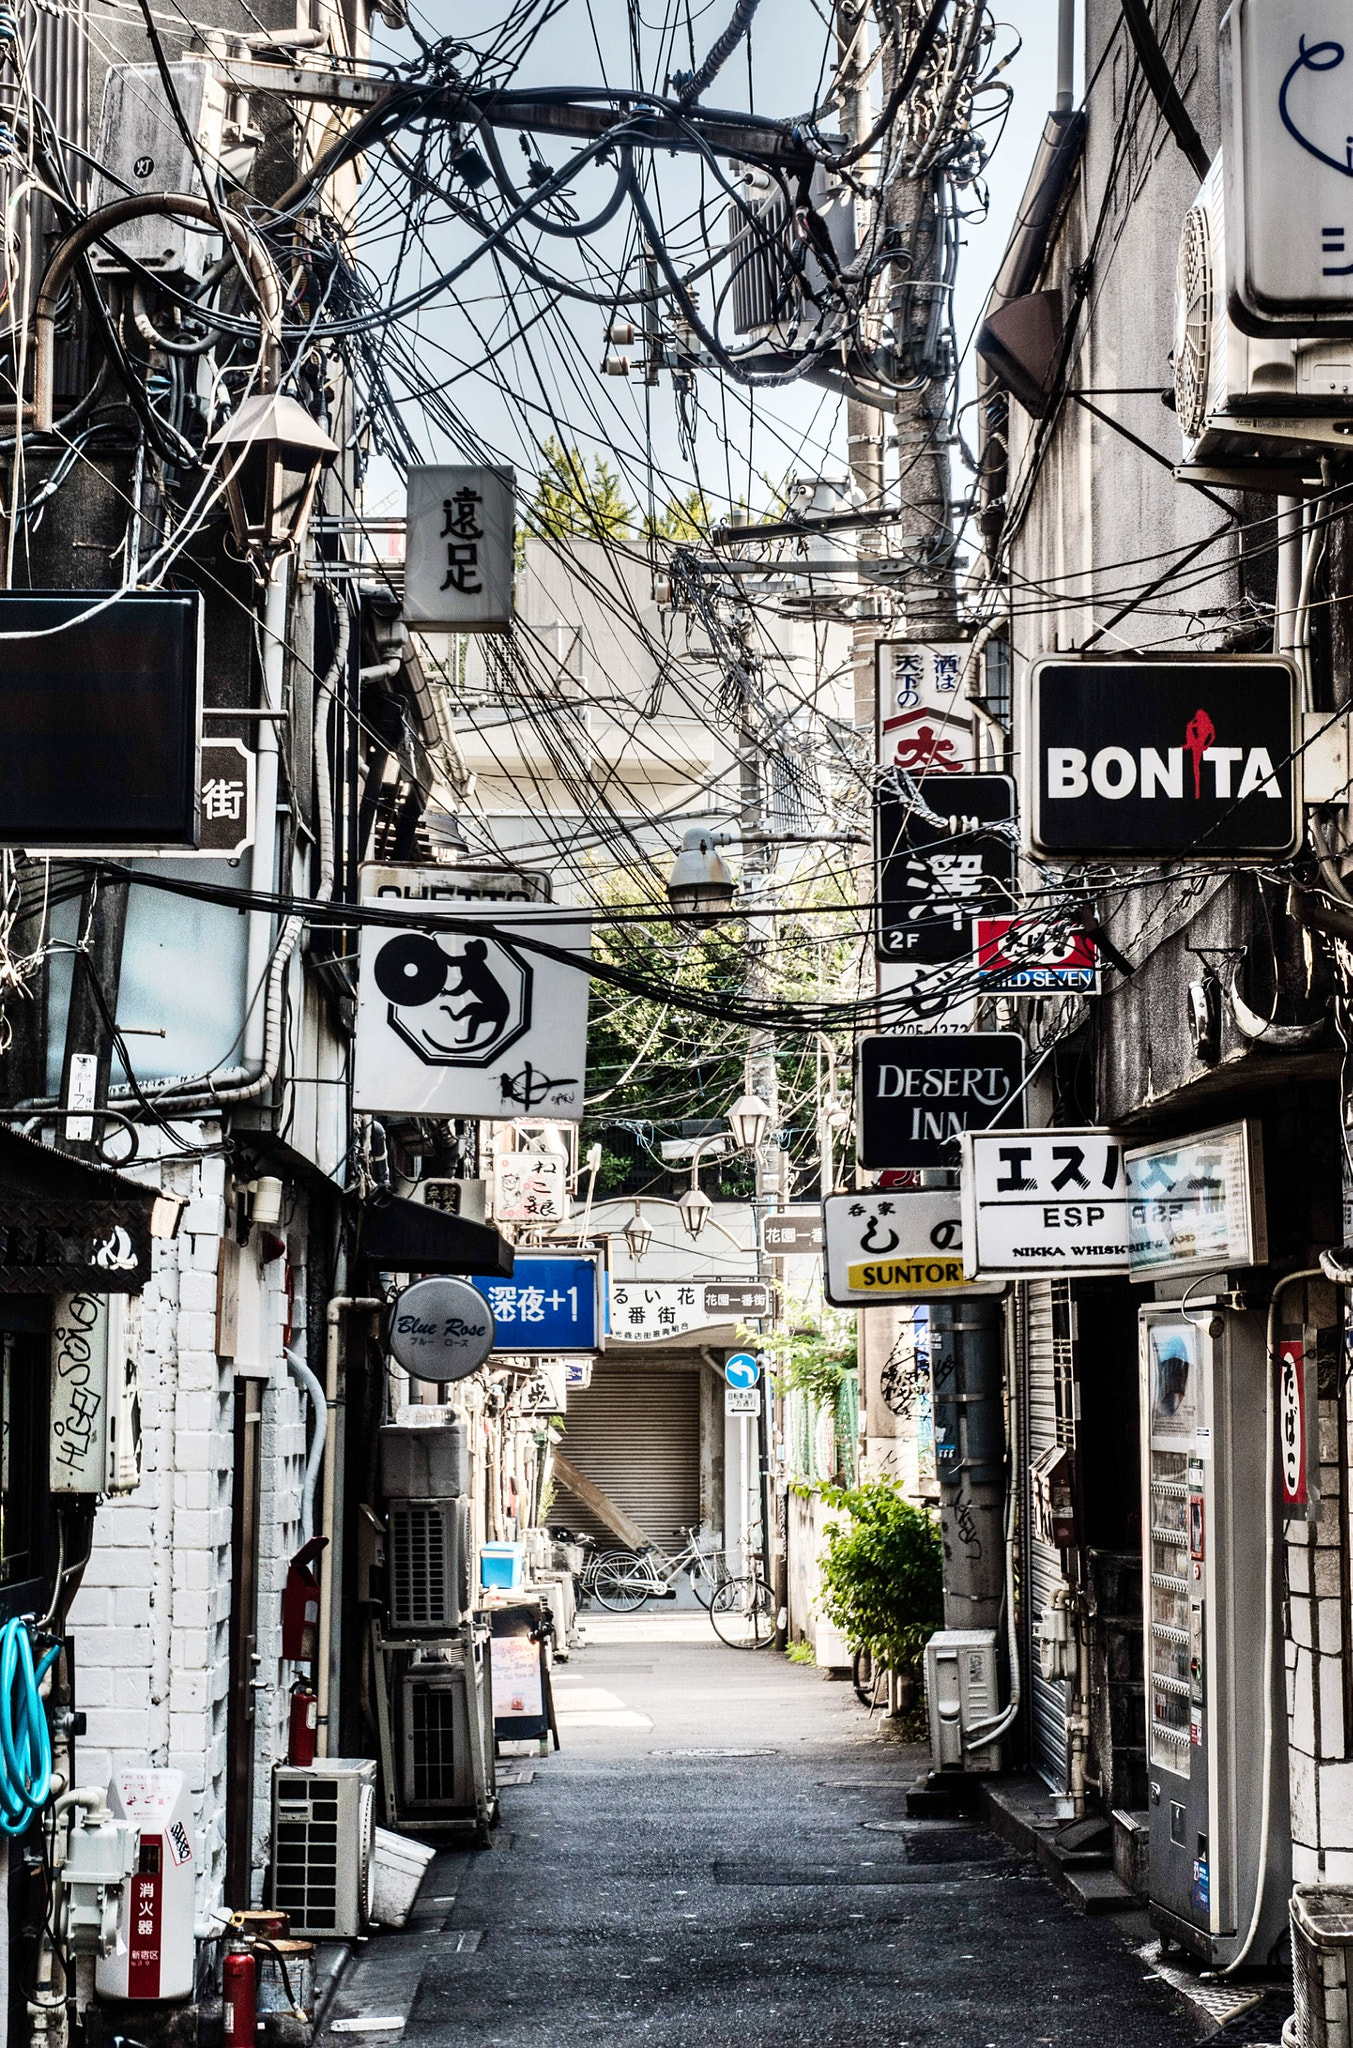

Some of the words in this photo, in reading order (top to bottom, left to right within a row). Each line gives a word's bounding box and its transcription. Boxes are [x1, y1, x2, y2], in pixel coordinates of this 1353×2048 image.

[440, 486, 484, 595] 遠足
[895, 654, 920, 707] 天下の
[933, 654, 957, 692] 酒は
[201, 779, 244, 820] 街
[889, 931, 920, 949] 2F
[876, 1064, 1011, 1106] DESERT
[910, 1107, 968, 1141] INN
[848, 1201, 896, 1217] 呑家
[1043, 1206, 1106, 1228] ESP
[1012, 1245, 1066, 1258] NIKKA
[1070, 1243, 1129, 1256] WHISK
[705, 1293, 766, 1307] 花園一番街
[397, 1315, 437, 1335] Blue
[443, 1318, 486, 1337] Rose
[138, 1882, 154, 1935] 消火器
[131, 1950, 159, 1960] 新宿区
